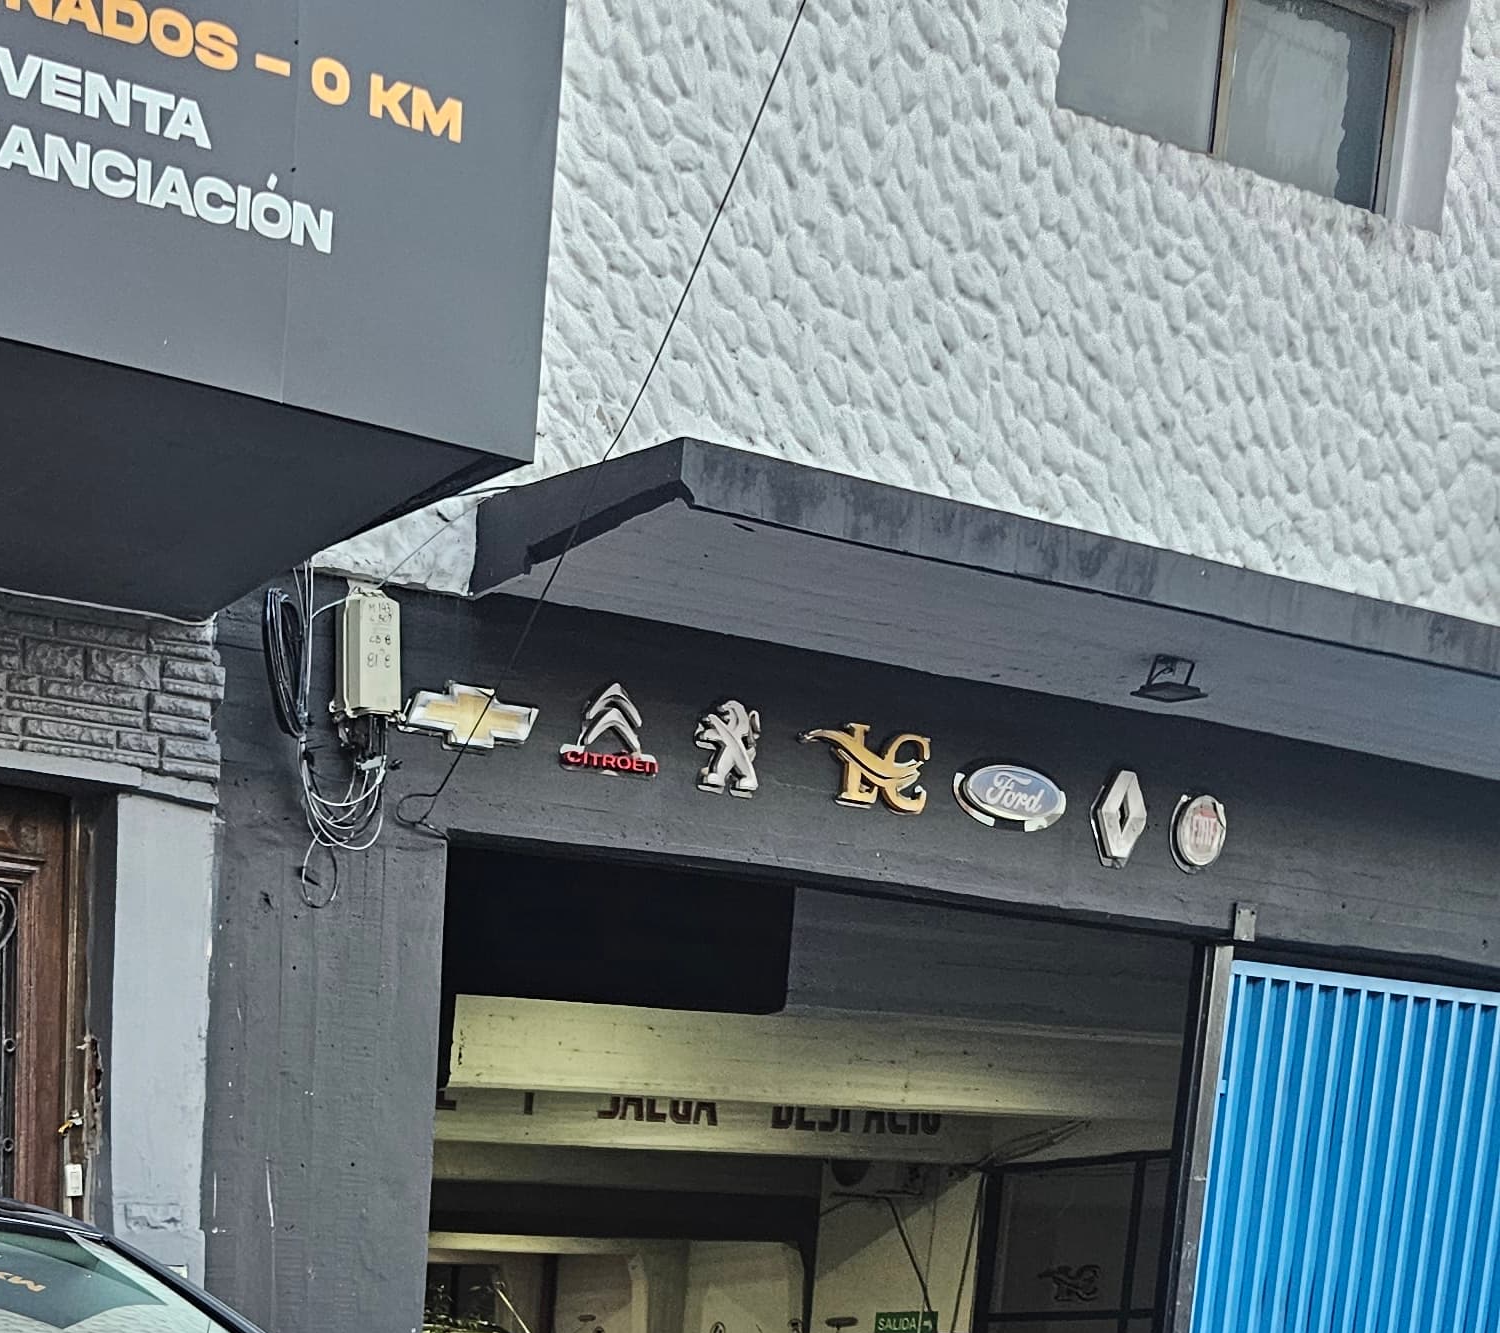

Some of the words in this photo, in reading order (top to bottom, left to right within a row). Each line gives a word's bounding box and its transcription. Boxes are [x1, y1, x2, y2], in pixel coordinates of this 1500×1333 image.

[311, 57, 350, 106] 0
[369, 73, 463, 144] KM
[985, 773, 1043, 814] Ford
[877, 1316, 918, 1332] SALIDA
